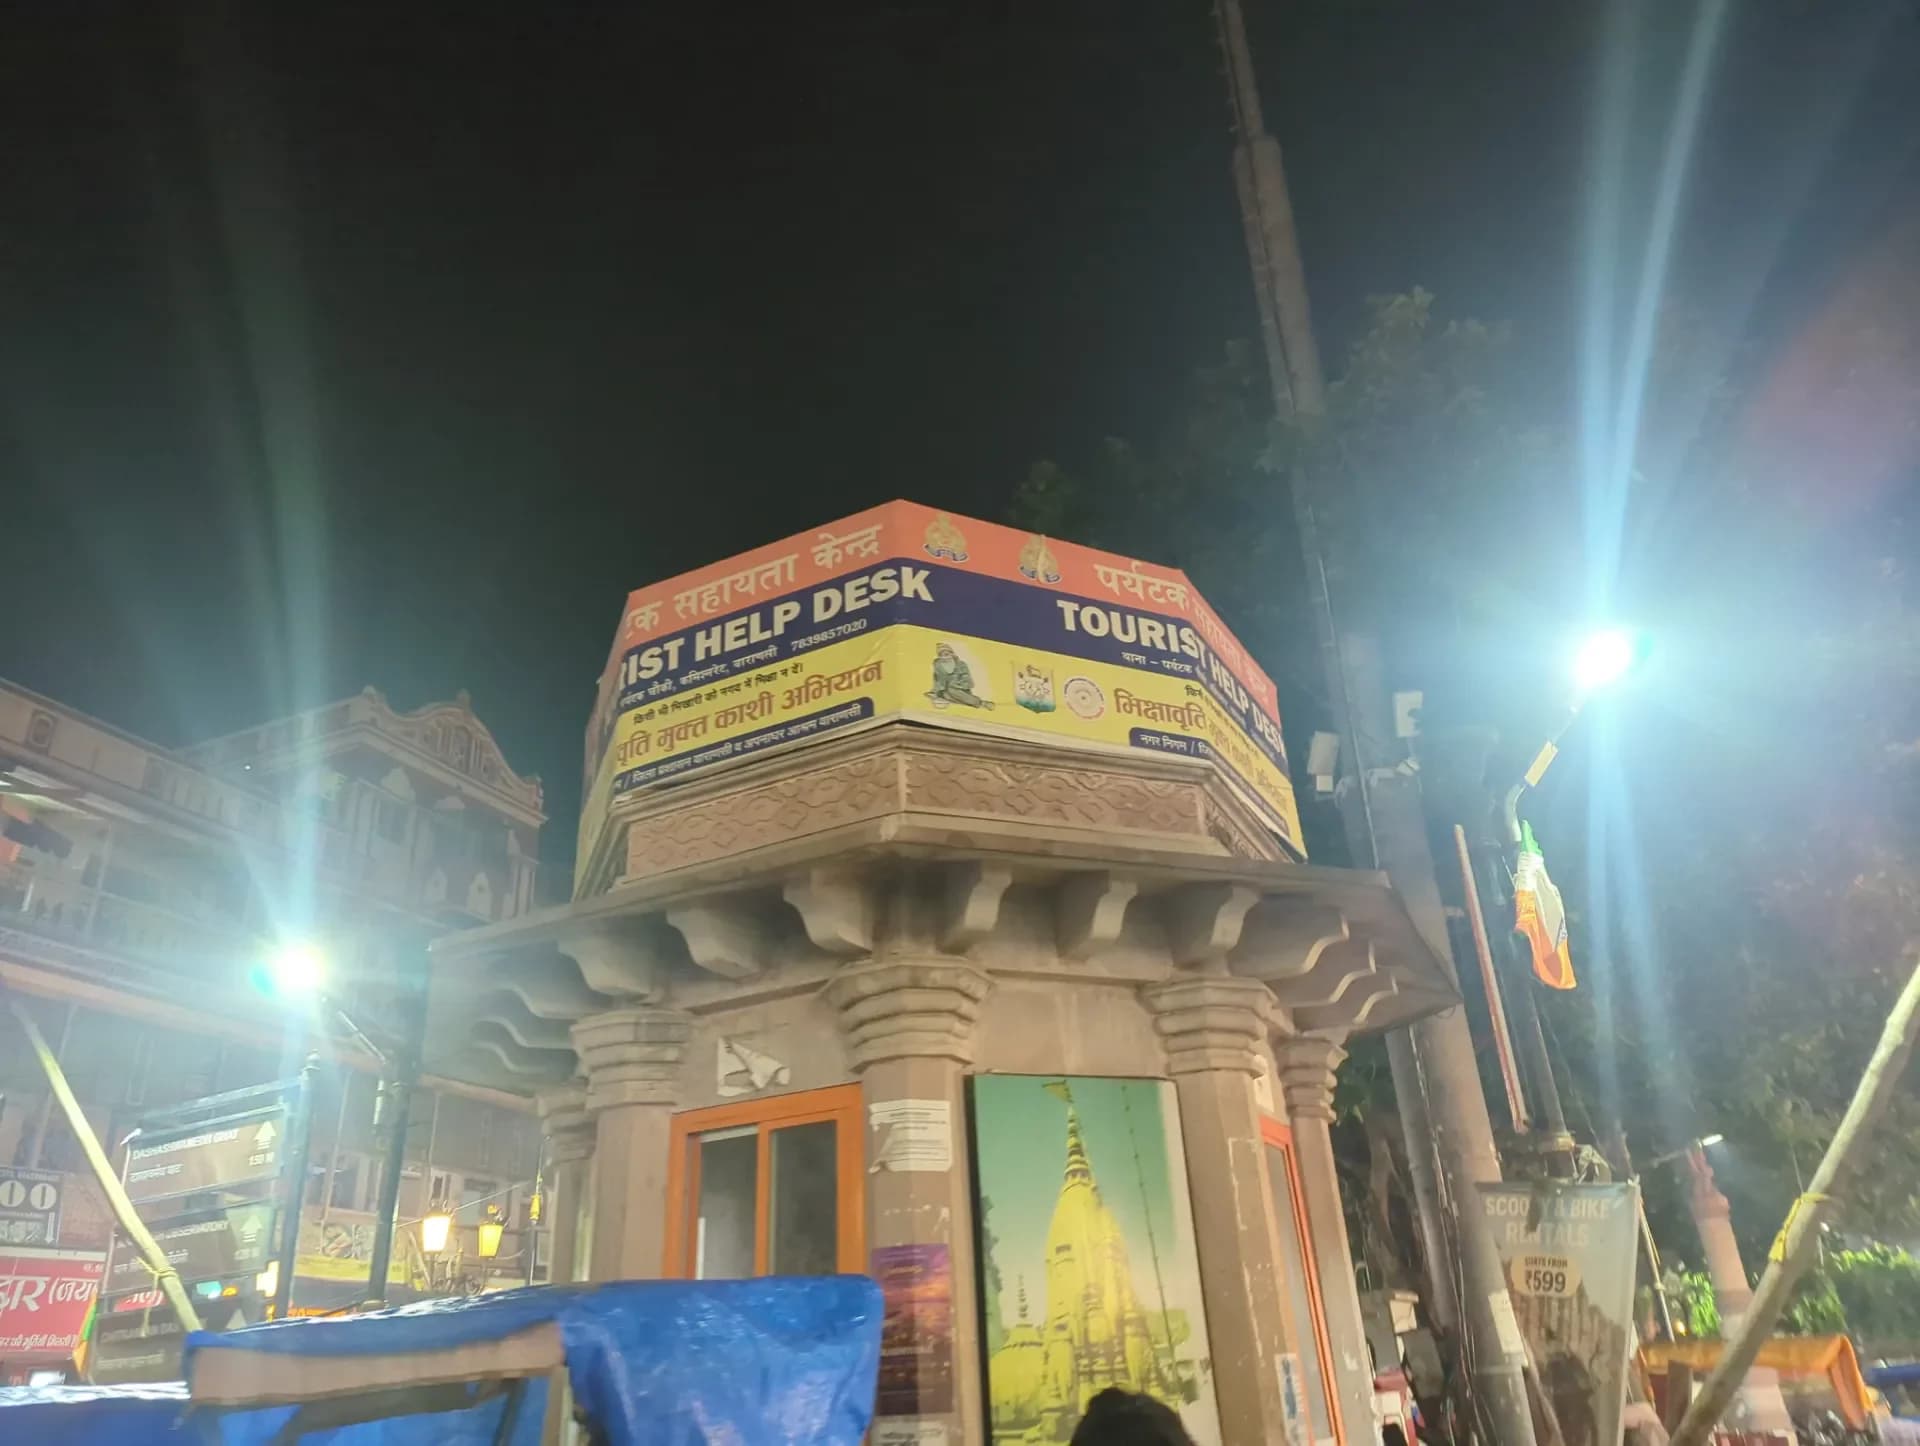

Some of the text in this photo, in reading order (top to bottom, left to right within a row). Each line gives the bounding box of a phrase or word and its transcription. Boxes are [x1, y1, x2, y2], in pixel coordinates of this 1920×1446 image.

[673, 554, 799, 620] सहायता
[811, 524, 883, 569] केन्द्र
[1093, 560, 1190, 611] पर्यटक
[695, 601, 800, 662] HELP
[813, 566, 934, 624] DESK
[1056, 599, 1207, 669] TOURIST
[656, 714, 710, 753] मुक्त
[714, 690, 776, 729] काशी
[781, 659, 884, 711] अभियान
[1485, 1196, 1552, 1218] SCOOY
[1570, 1197, 1610, 1219] BIKE
